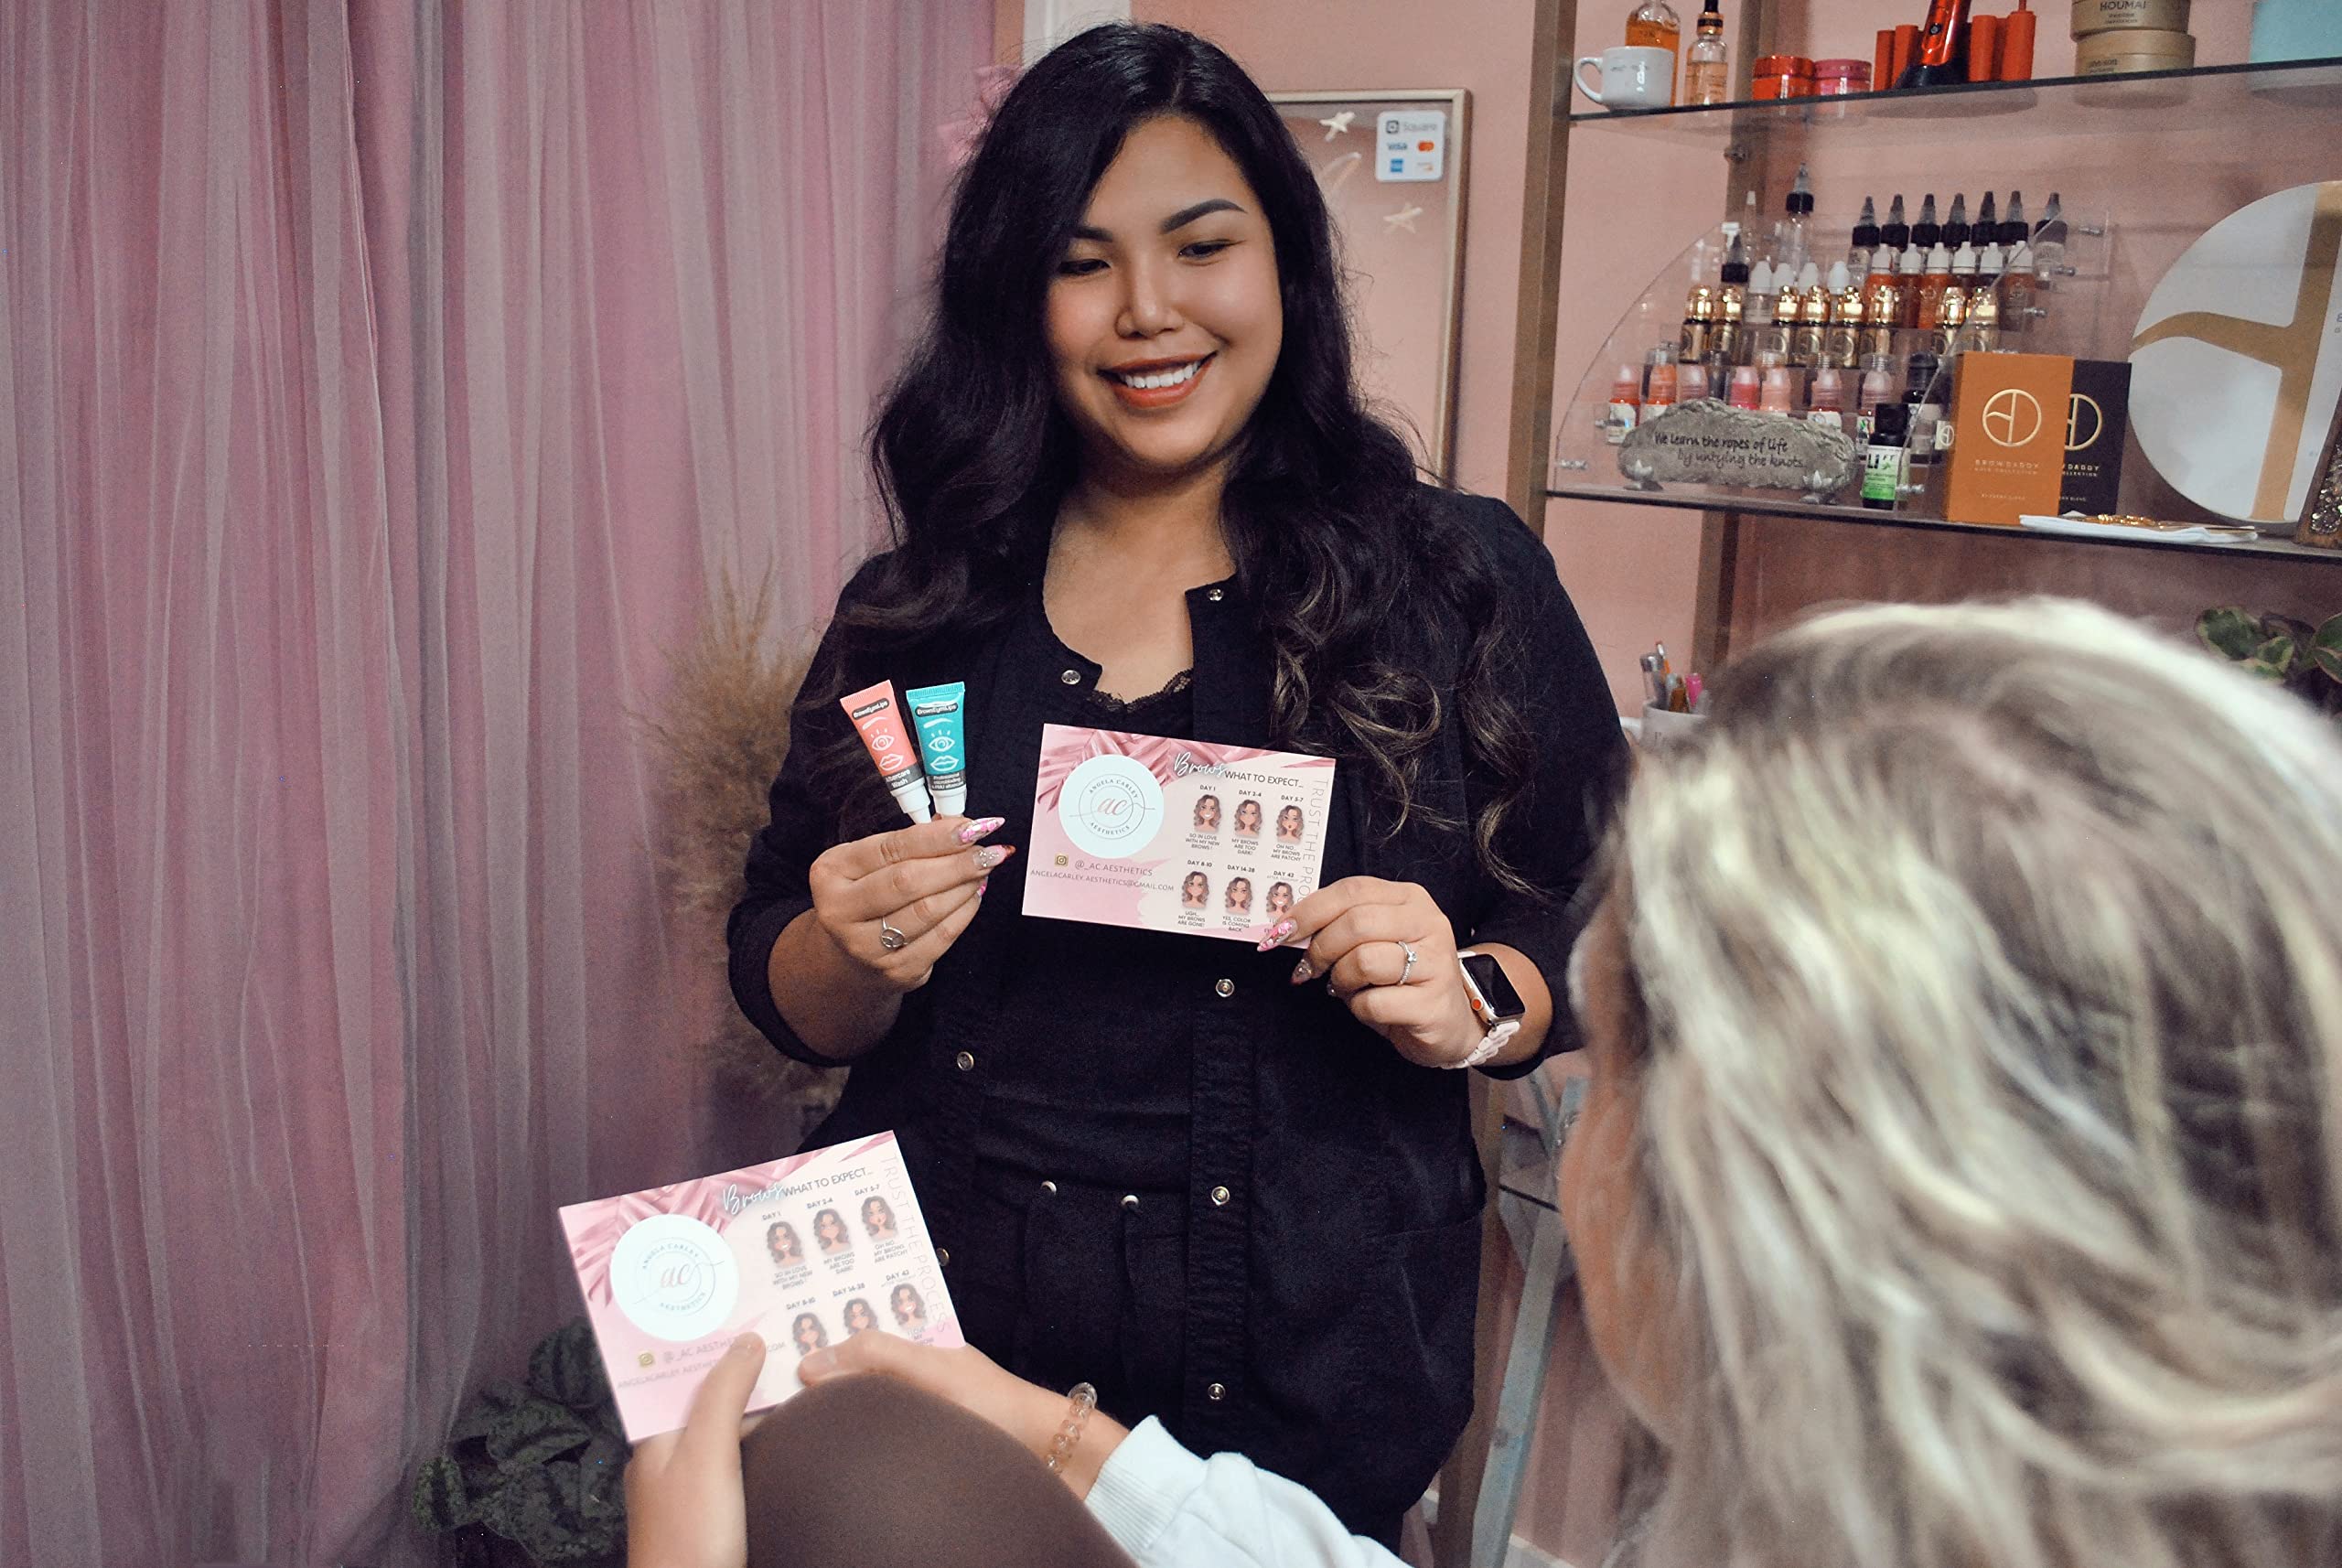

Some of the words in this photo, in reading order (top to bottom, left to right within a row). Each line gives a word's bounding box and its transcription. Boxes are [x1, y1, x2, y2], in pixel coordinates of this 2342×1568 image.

[2100, 1, 2146, 12] HOUMAI
[1654, 432, 1668, 445] We
[1702, 435, 1720, 447] the
[1722, 438, 1749, 453] ropes
[1753, 436, 1766, 454] of
[1678, 448, 1692, 467] by
[1696, 451, 1746, 469] untying
[1748, 454, 1766, 467] the
[1174, 752, 1228, 777] Brows
[1225, 770, 1251, 782] WHAT
[1252, 773, 1266, 783] TO
[1090, 779, 1114, 794] ANGELA
[1116, 779, 1139, 799] CARLEY
[1281, 794, 1293, 802] DAY
[1308, 779, 1329, 827] TRUST
[1090, 822, 1131, 835] AESTHETICS
[1303, 833, 1319, 862] THE
[782, 1181, 813, 1197] WHAT
[814, 1177, 830, 1188] TO
[854, 1187, 869, 1197] DAY
[723, 1180, 784, 1216] Brows
[806, 1200, 822, 1209] DAY
[762, 1212, 776, 1221] DAY
[880, 1153, 911, 1208] TRUST
[901, 1214, 923, 1254] THE
[913, 1254, 952, 1333] PROCESS
[833, 1251, 855, 1262] BROWS
[874, 1255, 886, 1263] ARE
[841, 1258, 855, 1268] TOO
[886, 1273, 900, 1282] DAY
[833, 1287, 848, 1297] DAY
[786, 1301, 801, 1311] DAY
